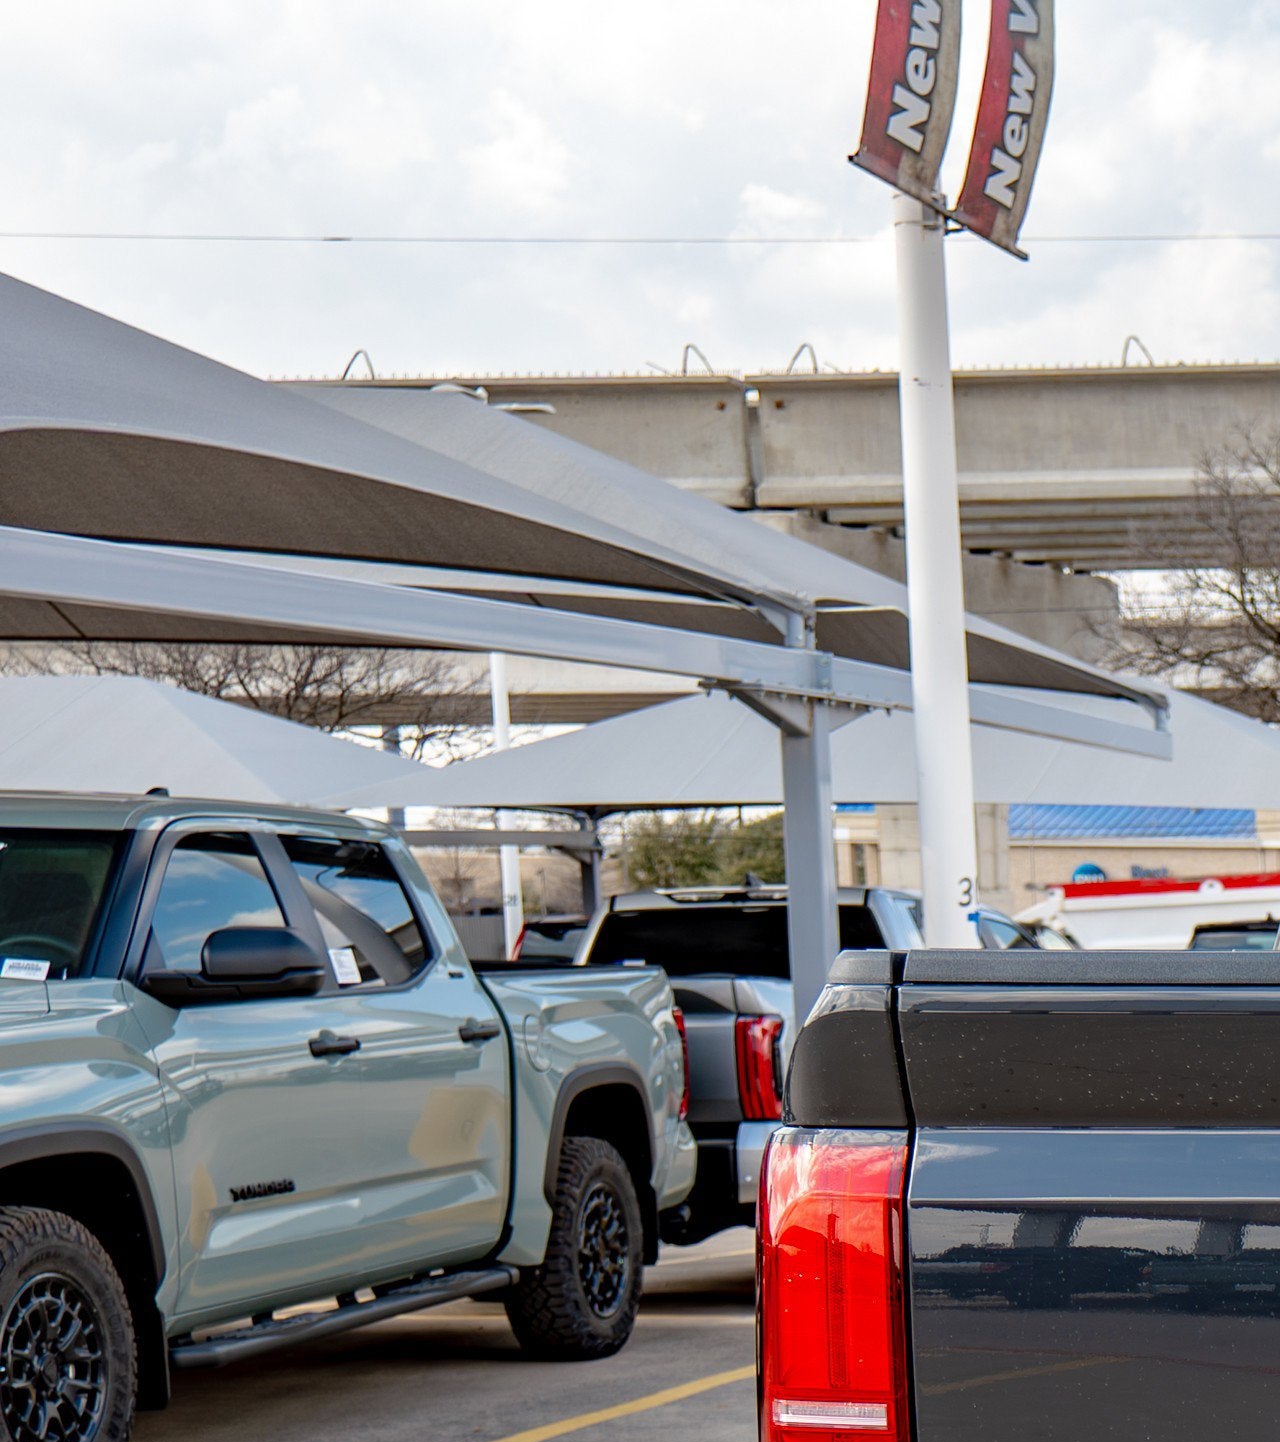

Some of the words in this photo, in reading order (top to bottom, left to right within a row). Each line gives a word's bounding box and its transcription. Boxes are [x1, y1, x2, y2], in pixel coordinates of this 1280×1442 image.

[886, 0, 943, 152] New
[983, 51, 1037, 209] New
[958, 877, 972, 907] 3
